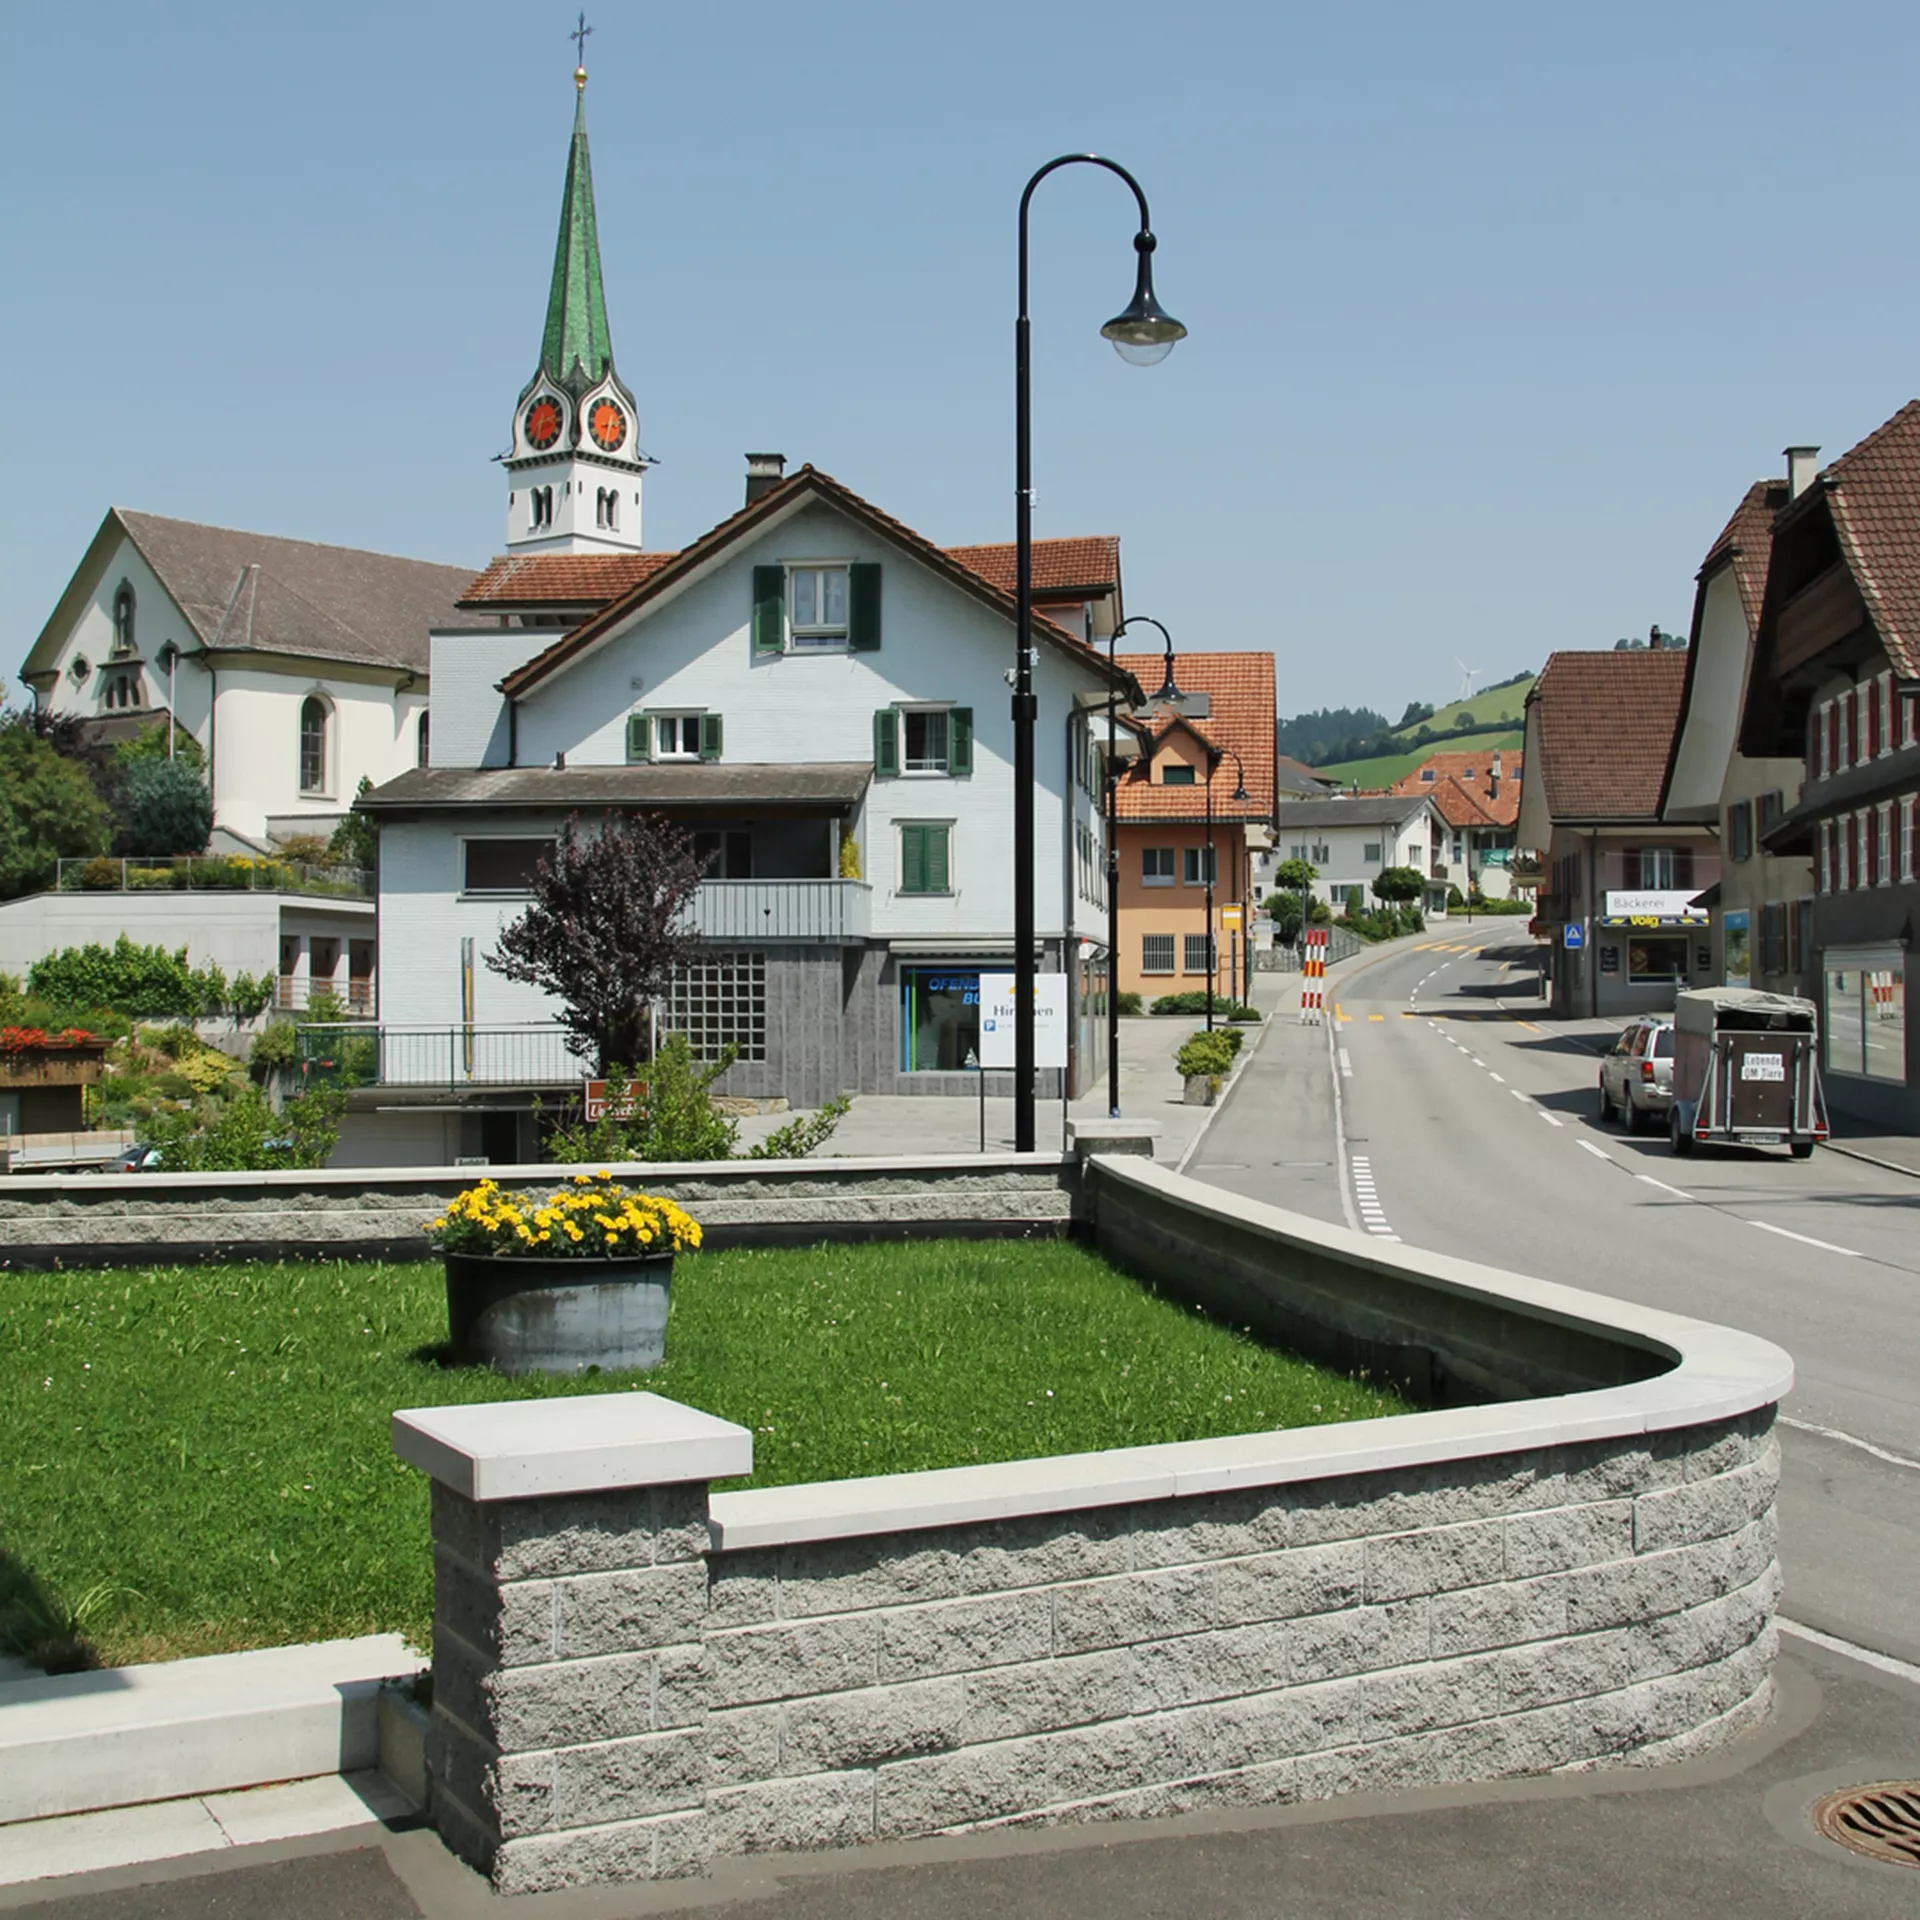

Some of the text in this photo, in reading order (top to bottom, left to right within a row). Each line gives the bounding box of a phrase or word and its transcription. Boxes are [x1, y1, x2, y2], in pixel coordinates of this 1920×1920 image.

[1630, 914, 1659, 928] Volg
[928, 977, 980, 991] OFENB
[993, 1004, 1053, 1016] Hiren
